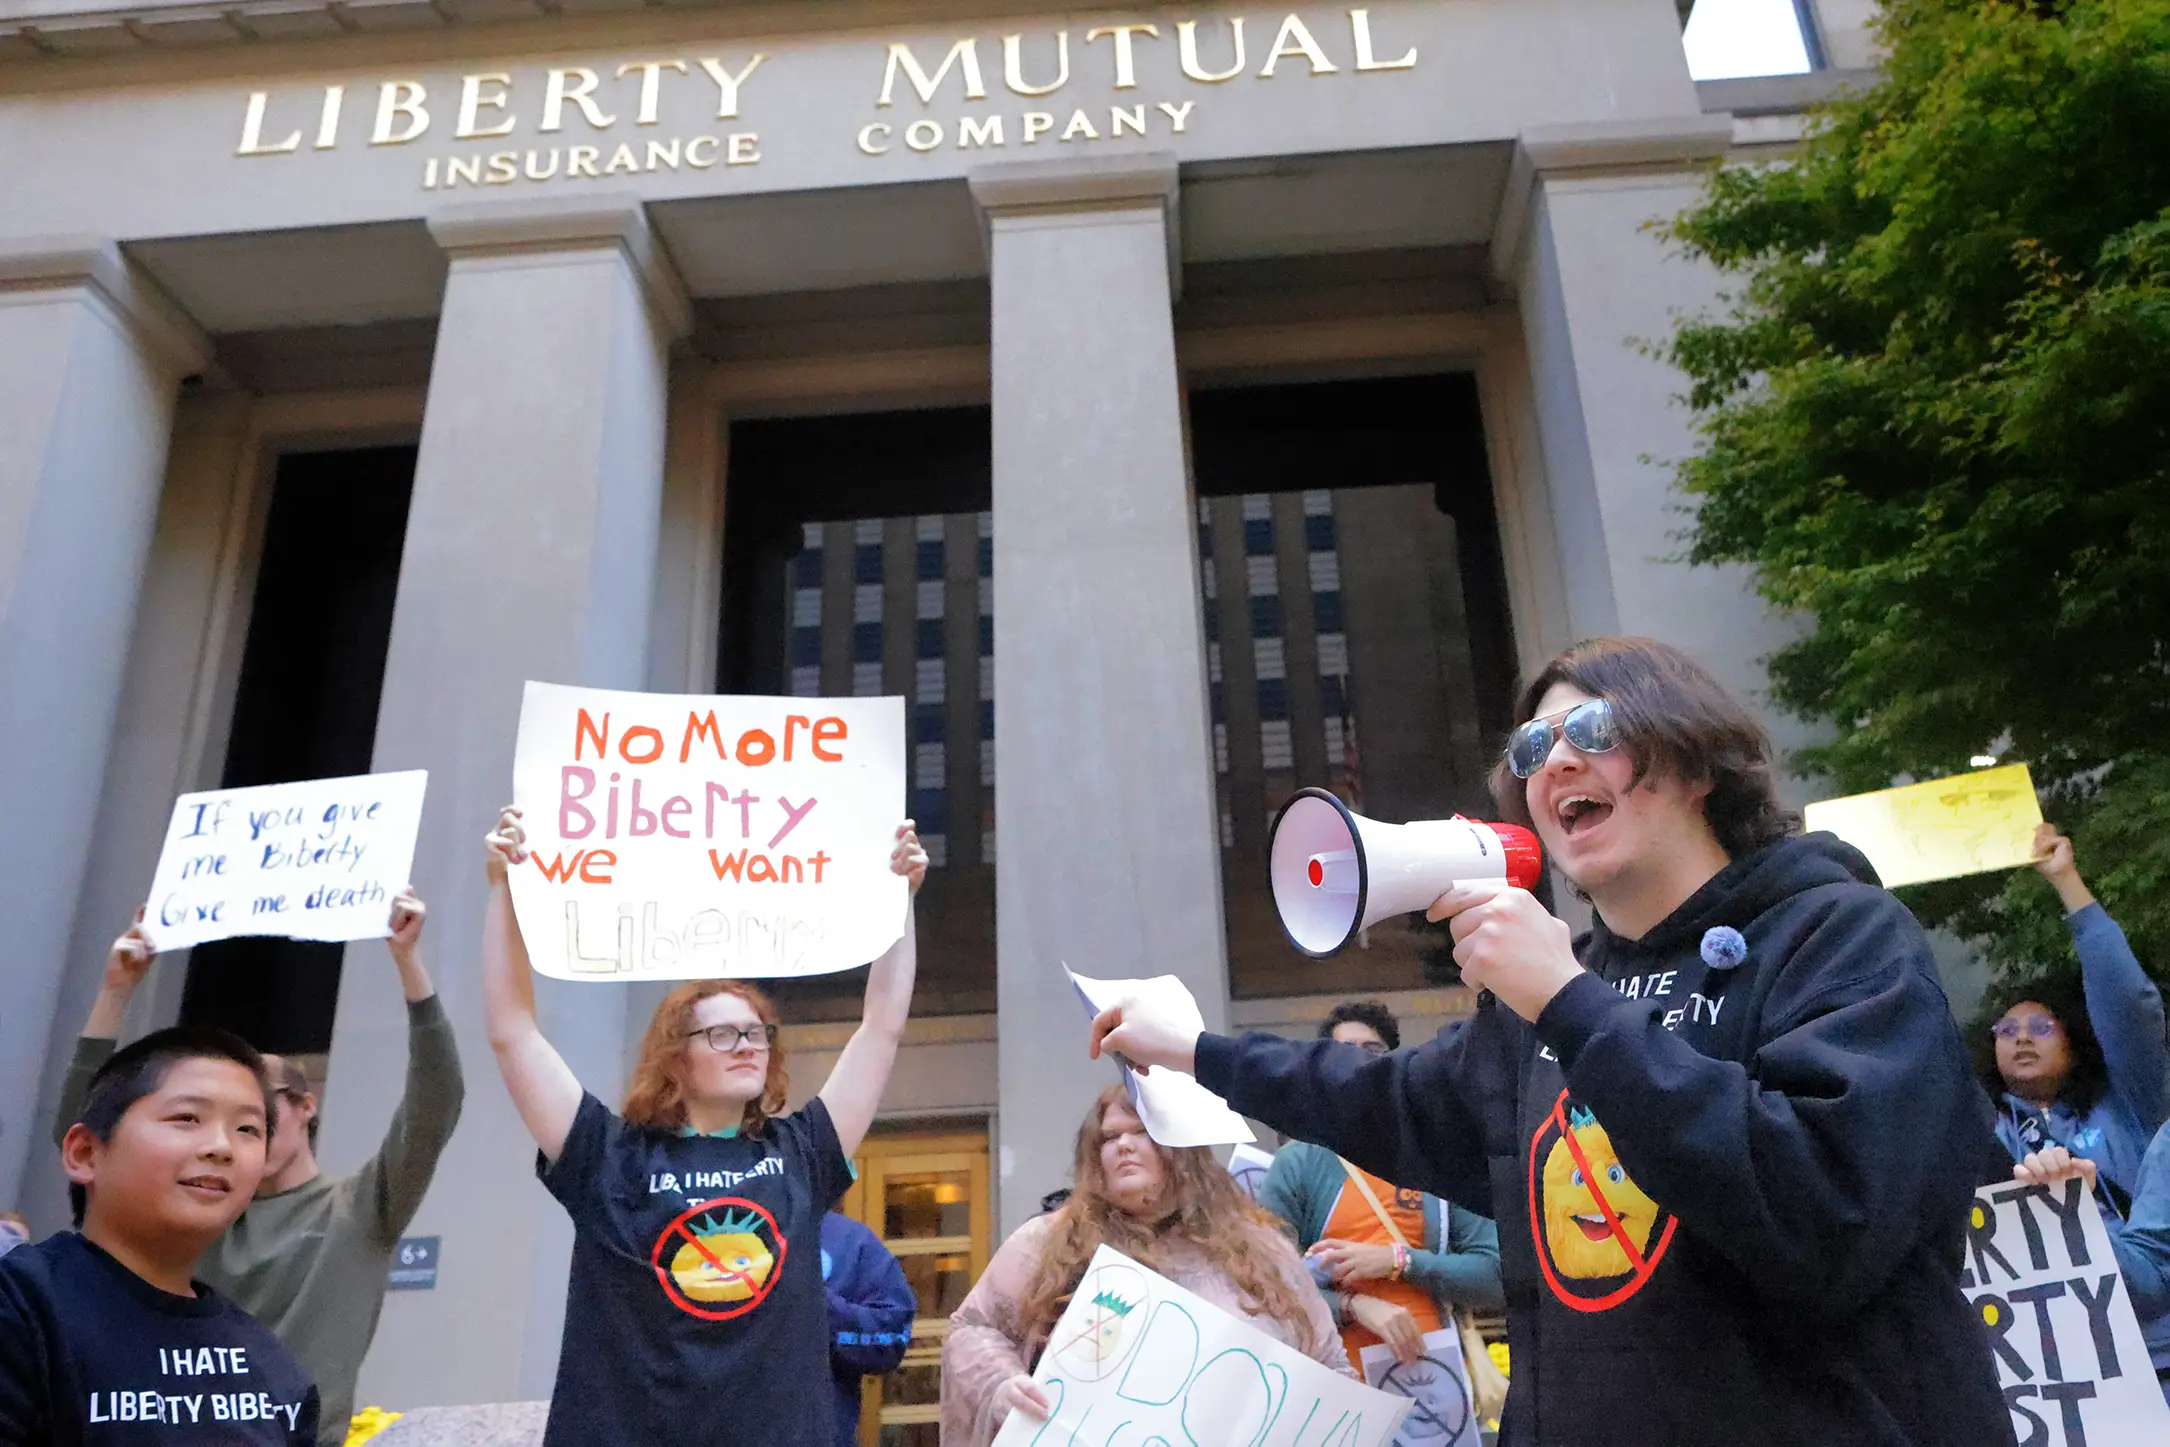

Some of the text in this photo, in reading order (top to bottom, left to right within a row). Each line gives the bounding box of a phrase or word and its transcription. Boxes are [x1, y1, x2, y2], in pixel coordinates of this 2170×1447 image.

[235, 8, 1418, 157] LIBERTY MUTUAL
[421, 101, 1195, 190] INSURANCE COMPANY
[575, 708, 848, 766] No More
[181, 800, 382, 840] If you give
[559, 766, 818, 849] Biberty
[181, 854, 227, 880] me
[161, 881, 385, 927] Give me death
[1961, 1176, 2093, 1289] RTY
[159, 1347, 249, 1376] I HATE
[90, 1391, 203, 1425] LIBERTY
